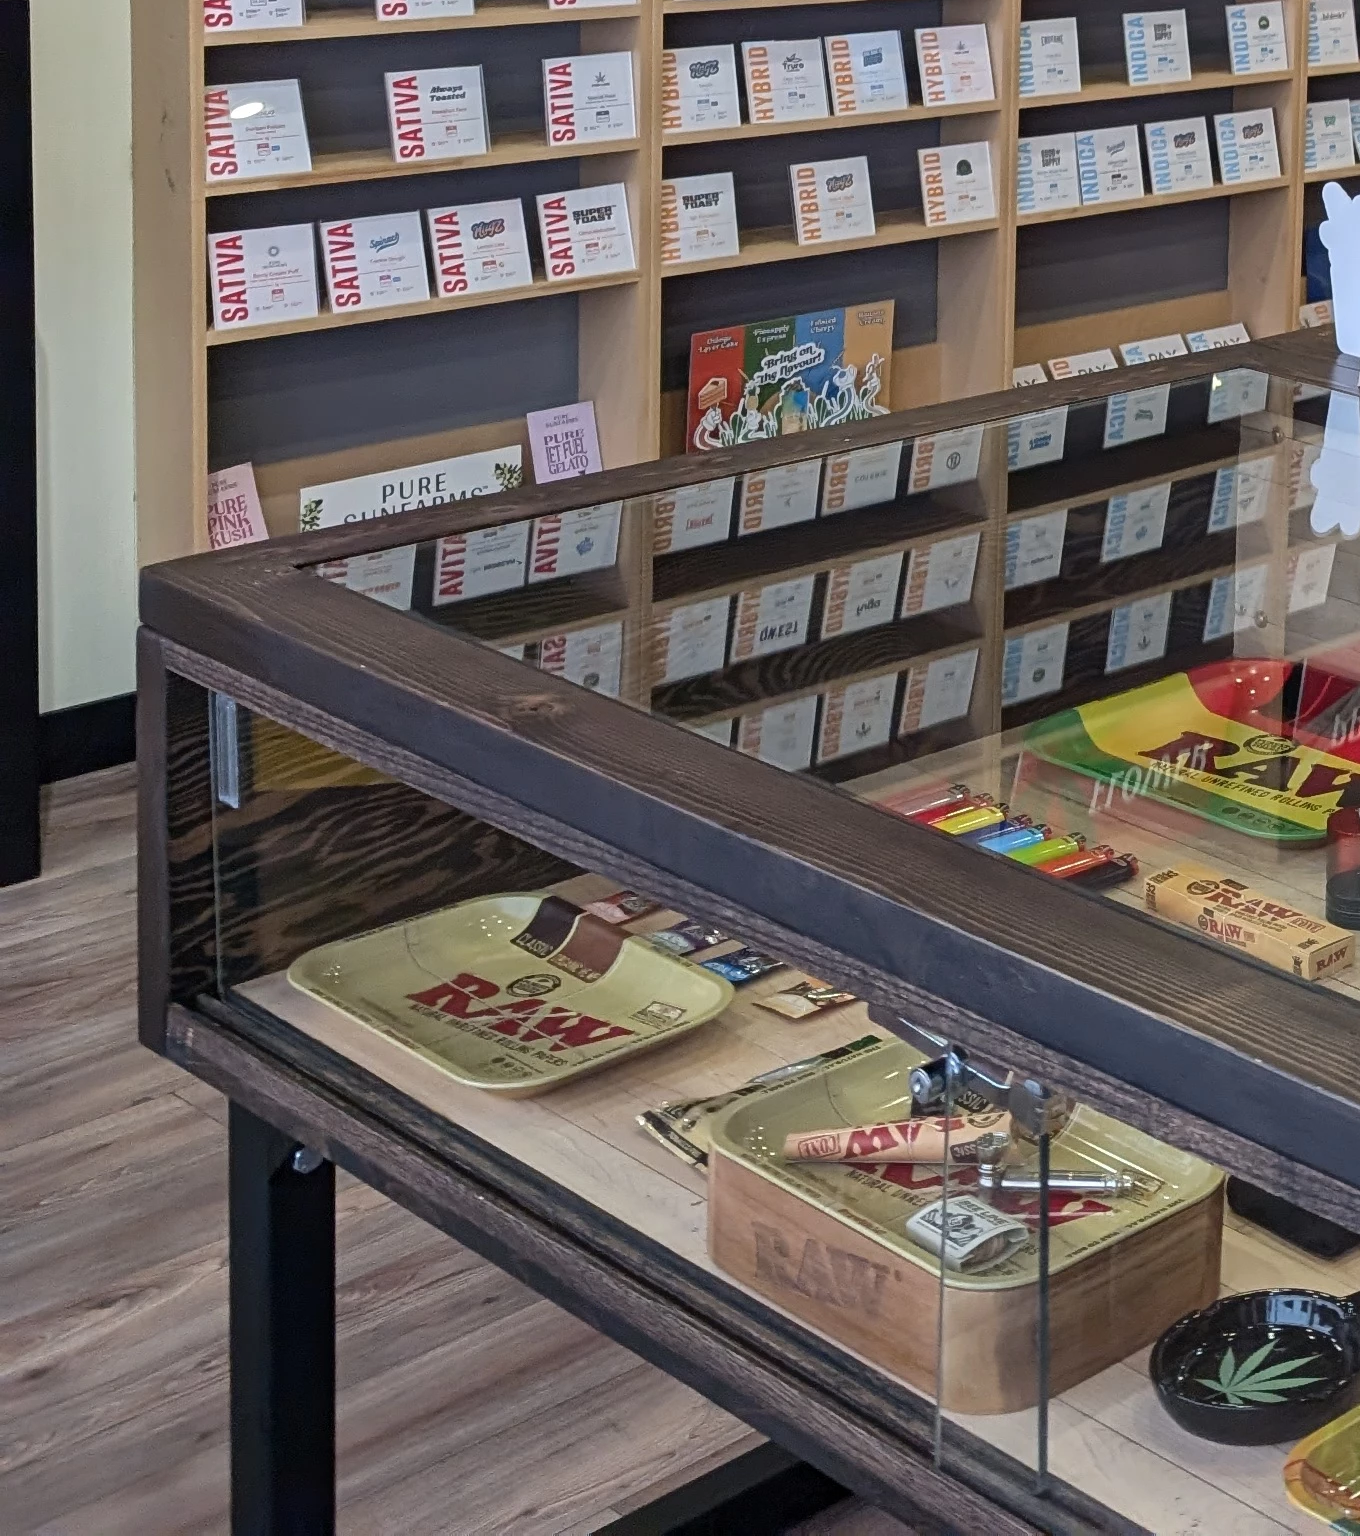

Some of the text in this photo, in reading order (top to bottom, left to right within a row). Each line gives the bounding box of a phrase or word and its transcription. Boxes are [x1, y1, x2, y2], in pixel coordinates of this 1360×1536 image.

[1128, 16, 1150, 84] INDICA
[430, 84, 463, 94] Always
[749, 46, 774, 121] HYBRID
[429, 91, 466, 102] Toasted
[393, 77, 424, 157] SATIVA
[682, 192, 719, 202] SUPER
[683, 200, 719, 209] TOAST
[797, 167, 821, 241] HYBRID
[572, 206, 612, 218] SUPER
[573, 214, 613, 224] TOAST
[436, 213, 467, 292] SATIVA
[765, 345, 817, 369] Bring on
[544, 428, 585, 445] PURE
[562, 438, 588, 460] FUEL
[548, 455, 589, 475] GELATO
[382, 473, 447, 504] PURE
[207, 512, 252, 533] PINK
[210, 528, 254, 550] KUSH
[1200, 774, 1272, 798] UNREFINED
[1271, 793, 1321, 813] ROLLING
[1204, 888, 1304, 921] RAW
[1207, 921, 1244, 941] RAW
[515, 933, 553, 957] CLASSIC
[1316, 946, 1349, 974] RAW
[404, 972, 636, 1052] RAW
[845, 1169, 889, 1194] NATURAL
